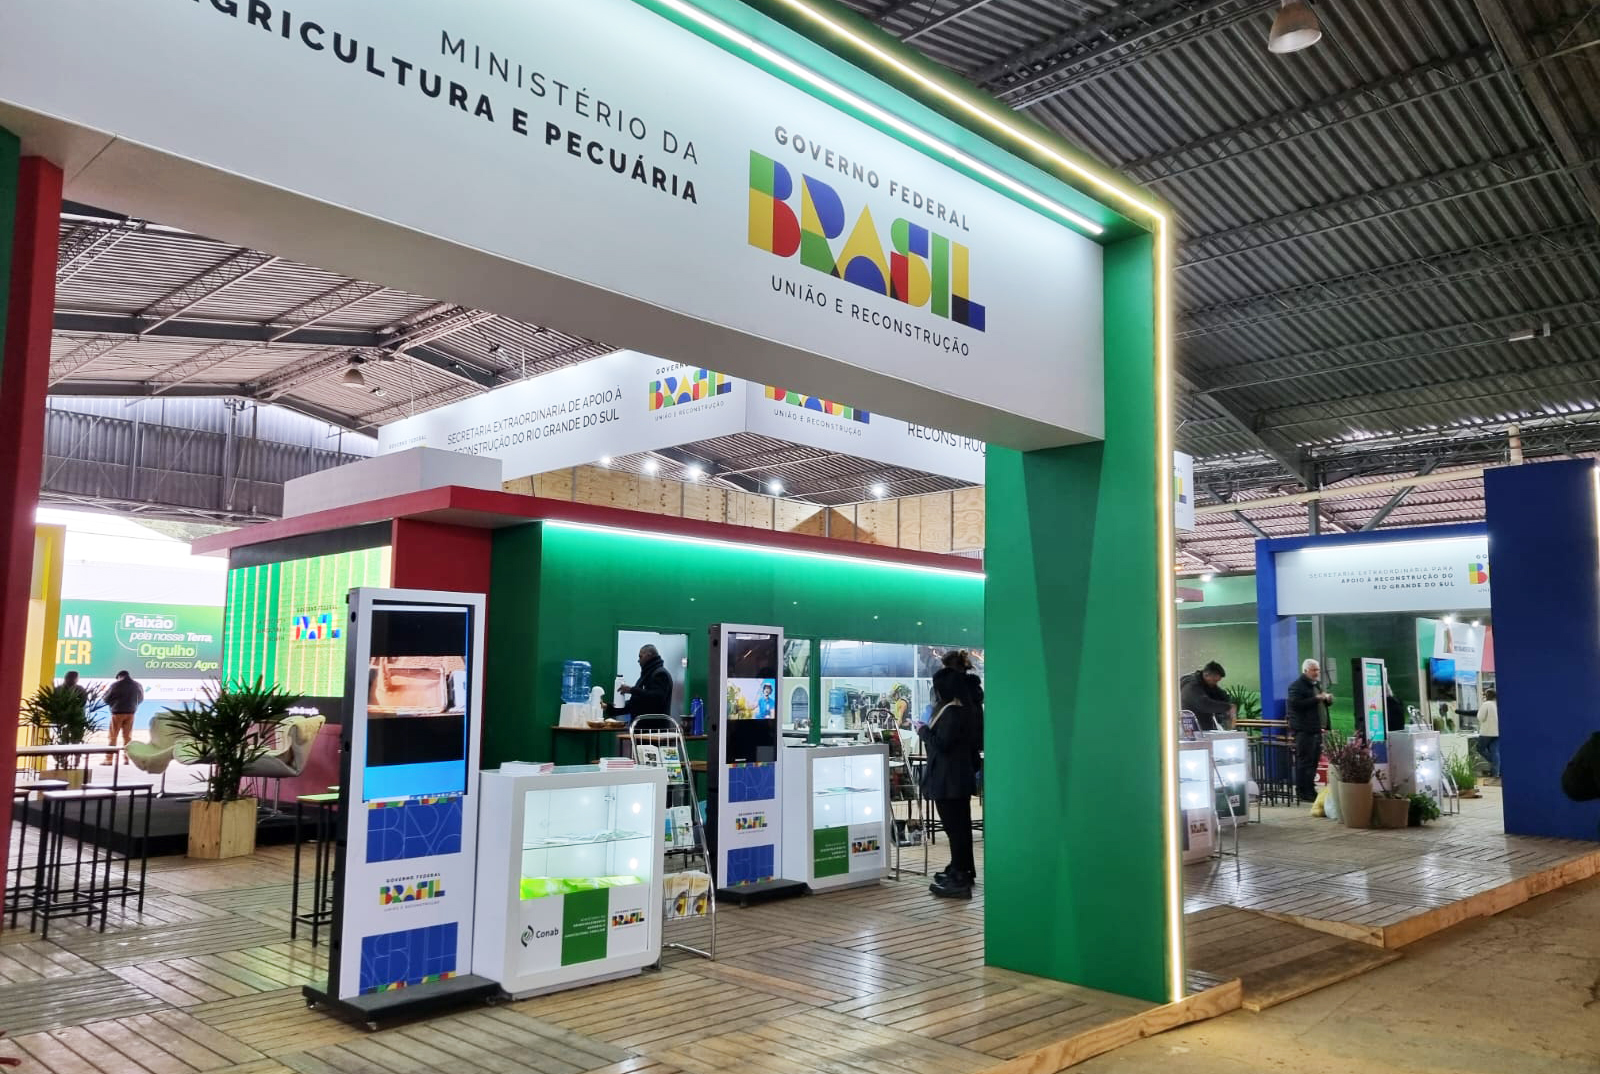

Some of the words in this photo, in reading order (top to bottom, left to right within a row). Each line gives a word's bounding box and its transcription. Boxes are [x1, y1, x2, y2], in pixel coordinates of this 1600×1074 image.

[191, 0, 494, 122] GRICULTURA
[512, 107, 528, 135] E
[545, 121, 698, 204] PECUÁRIA
[441, 30, 647, 140] MINISTÉRIO
[662, 130, 698, 165] DA
[774, 126, 880, 188] GOVERNO
[889, 180, 970, 232] FEDERAL
[748, 149, 985, 333] BRASIL
[771, 274, 827, 307] UNIÃO
[835, 298, 843, 314] E
[851, 304, 969, 357] RECONSTRUÇÃO
[649, 368, 731, 411] BRASIL
[447, 423, 492, 445] SECRETARIA
[568, 398, 580, 413] DE
[582, 389, 612, 409] APOIO
[512, 432, 525, 445] DO
[526, 427, 541, 442] RIO
[543, 417, 580, 437] GRANDE
[583, 414, 597, 428] DO
[599, 408, 619, 423] SUL
[64, 614, 92, 638] NA
[125, 614, 174, 629] Paixão
[153, 632, 184, 642] nossa
[140, 644, 195, 659] Orgulho
[145, 660, 160, 669] do
[161, 661, 192, 669] nosso
[379, 879, 446, 906] BRASIL
[535, 927, 559, 939] Conab
